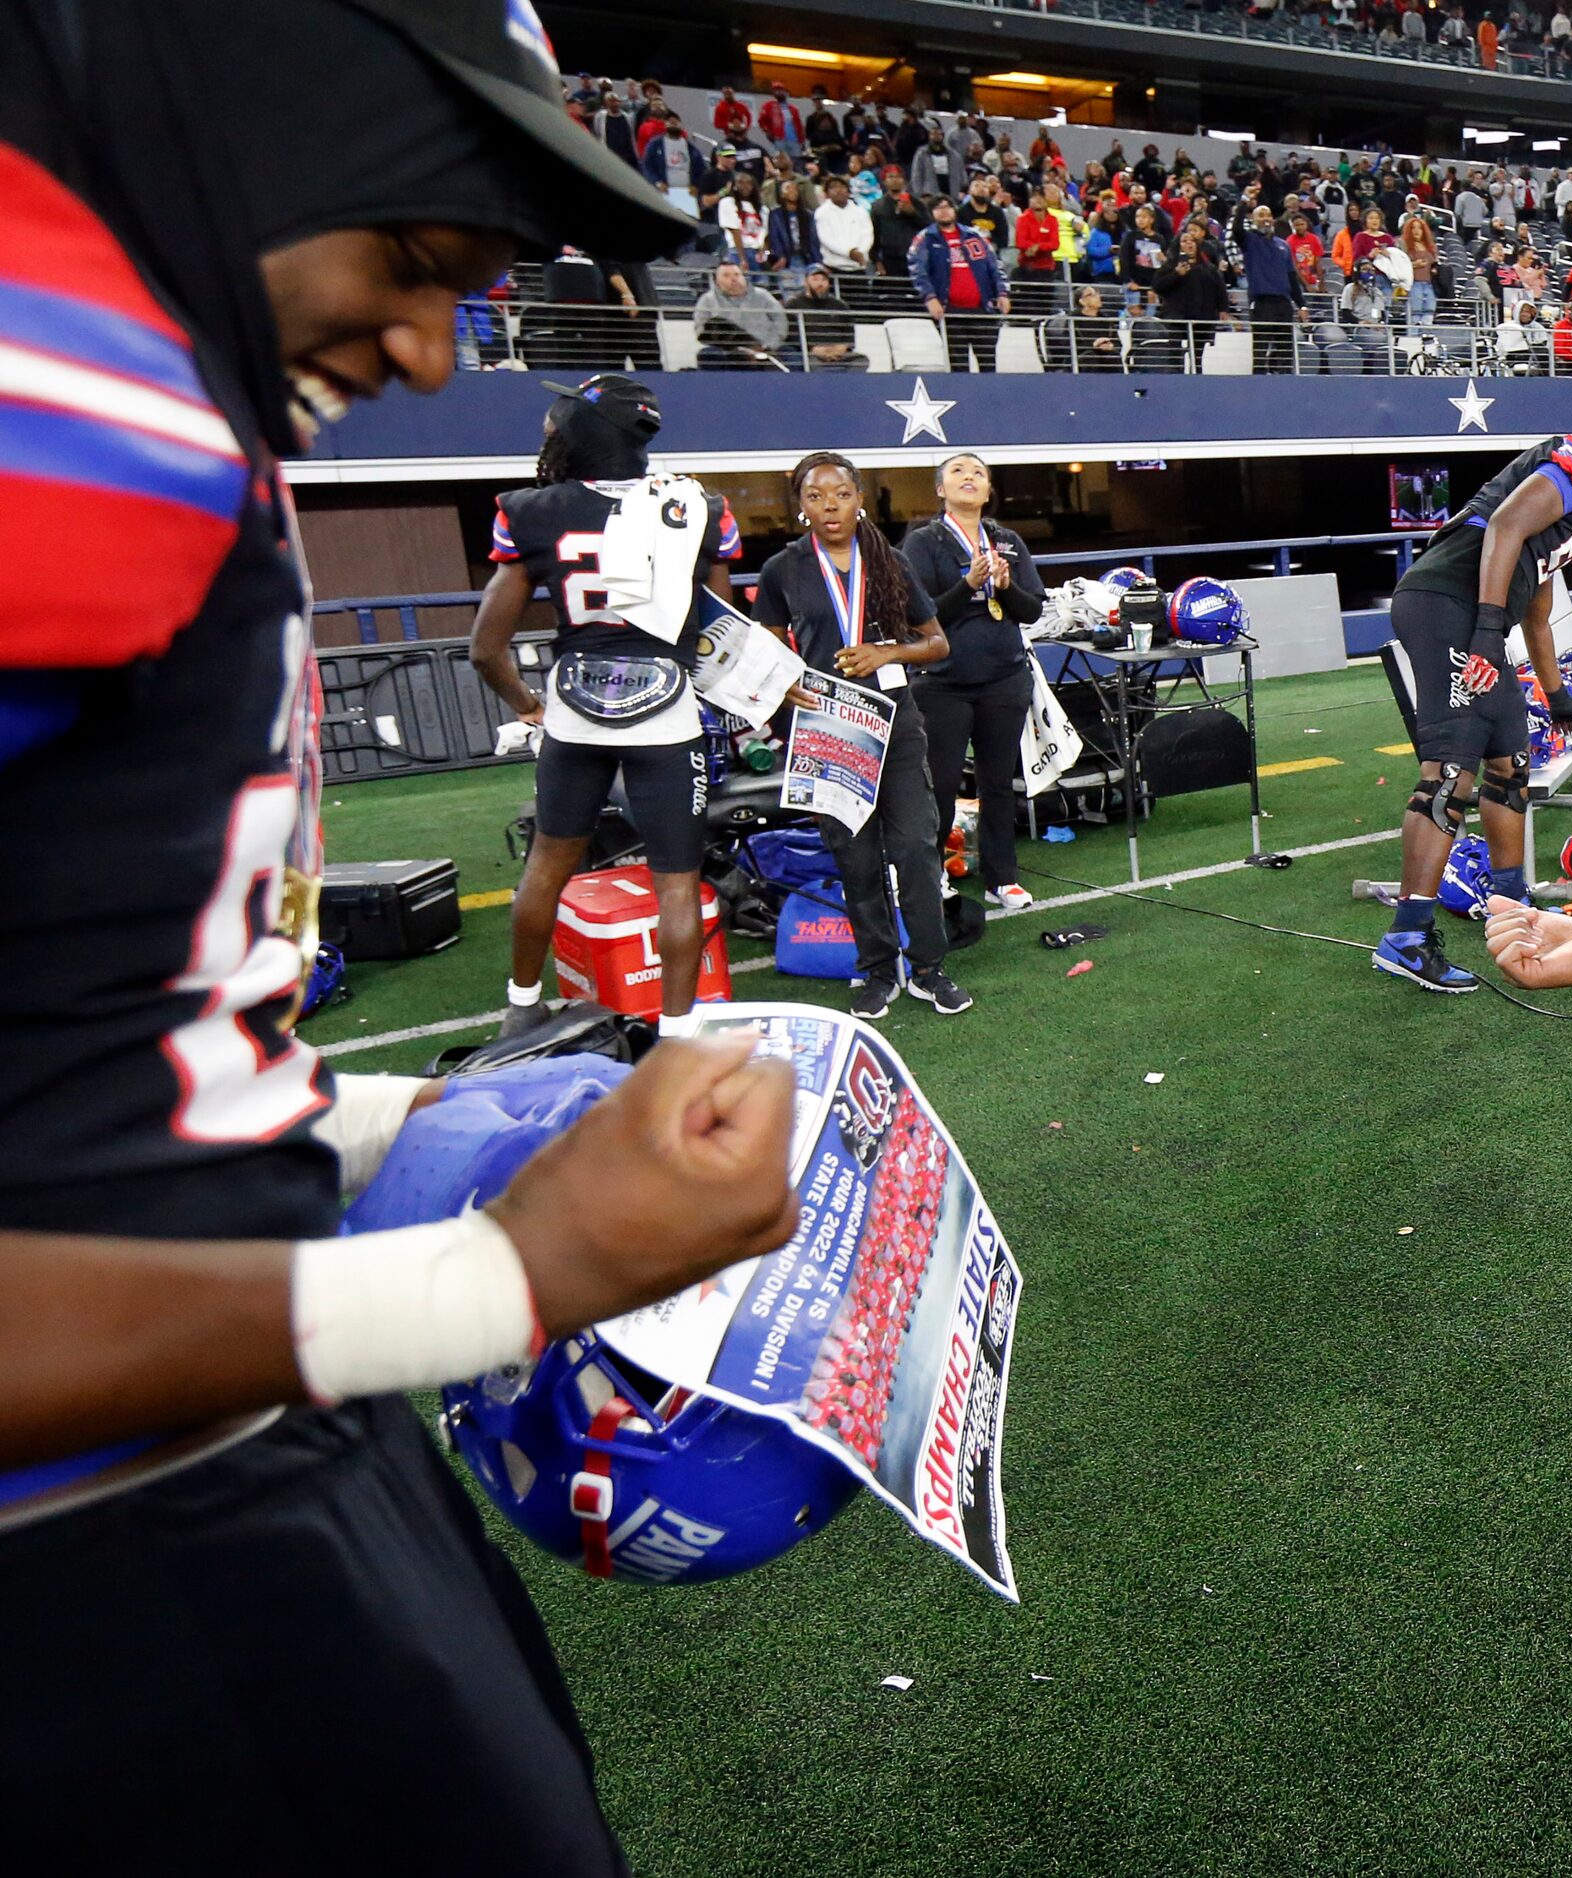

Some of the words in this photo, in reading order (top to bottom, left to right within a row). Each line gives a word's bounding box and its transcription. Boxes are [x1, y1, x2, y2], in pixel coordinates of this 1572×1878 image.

[582, 672, 649, 688] Riddell
[839, 705, 889, 740] CHAMPS!
[690, 751, 709, 816] D'Ville
[624, 966, 662, 986] BODY
[806, 1151, 839, 1207] STATE
[829, 1166, 855, 1213] YOUR
[751, 1204, 817, 1319] CHAMPIONS
[808, 1211, 840, 1263] 2022
[821, 1179, 867, 1297] DUNCANVILLE
[793, 1263, 818, 1292] 6A
[959, 1208, 995, 1343] STATE
[754, 1293, 805, 1379] DIVISION
[808, 1296, 831, 1321] IS
[923, 1332, 971, 1550] CHAMPS!
[963, 1345, 984, 1508] FOOTBALL
[988, 1470, 998, 1542] CHAMPIONSHIP
[993, 1542, 1006, 1581] EDITION
